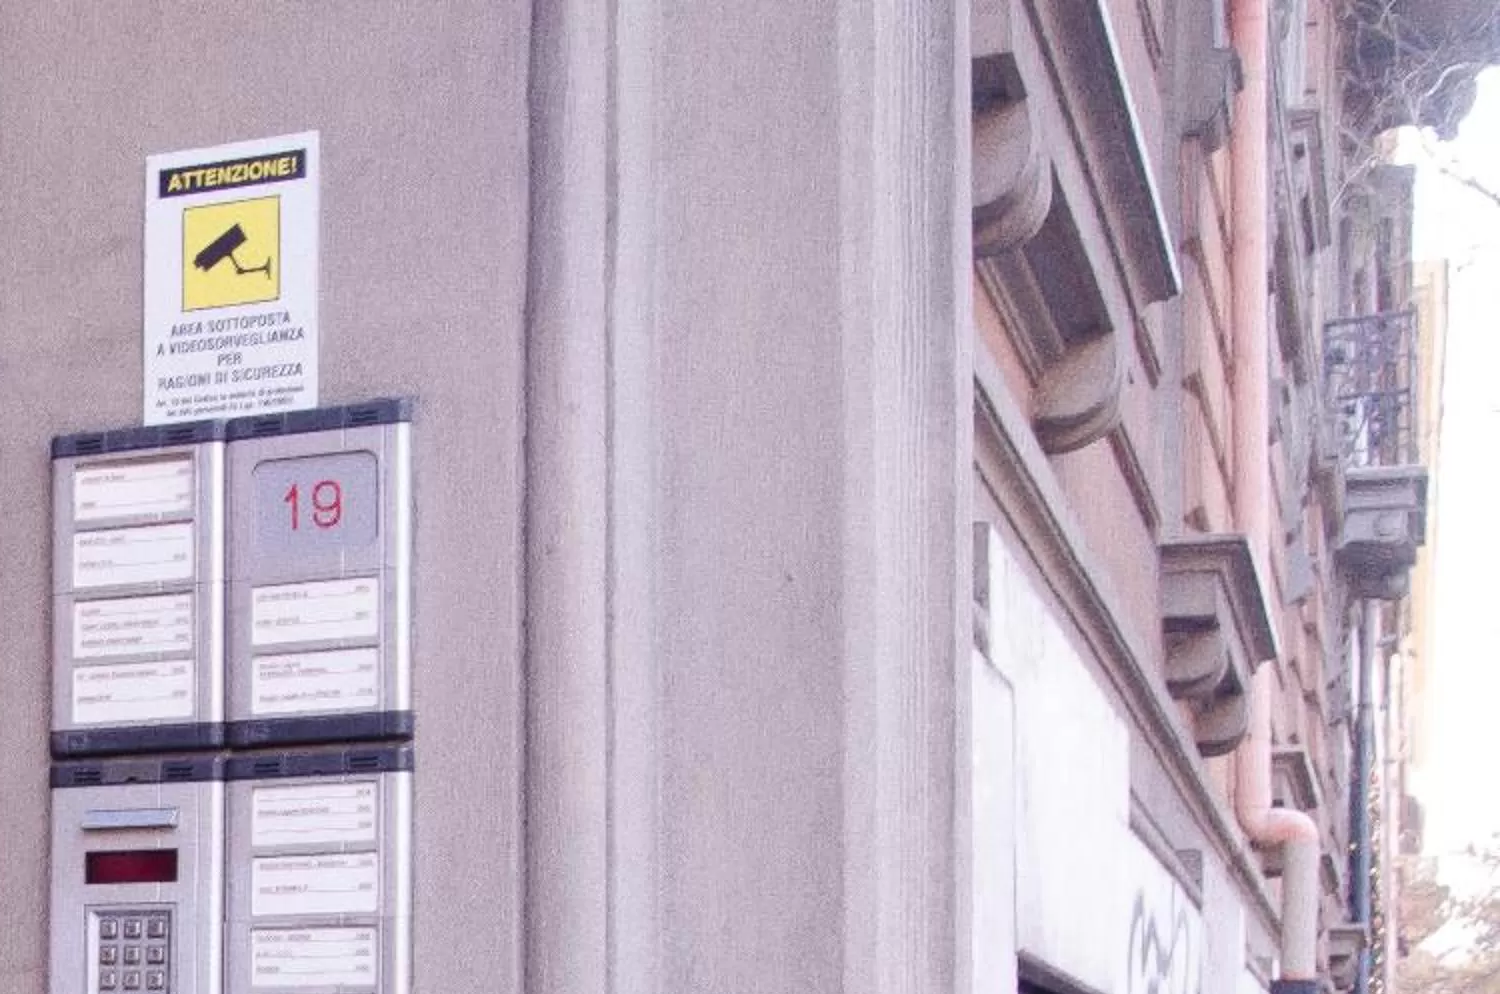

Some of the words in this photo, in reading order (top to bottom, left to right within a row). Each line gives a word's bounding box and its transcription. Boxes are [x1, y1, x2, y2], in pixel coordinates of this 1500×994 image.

[167, 156, 297, 192] ATTENZIONE!
[171, 321, 203, 337] AREA
[208, 310, 290, 333] SOTTOPOSTA
[156, 343, 165, 357] A
[169, 327, 304, 355] VIDEOSORVEGLIANZA
[217, 351, 242, 366] PER
[158, 372, 211, 390] RAGIONI
[215, 371, 229, 384] DI
[232, 362, 303, 382] SICUREZZA
[283, 480, 341, 530] 19
